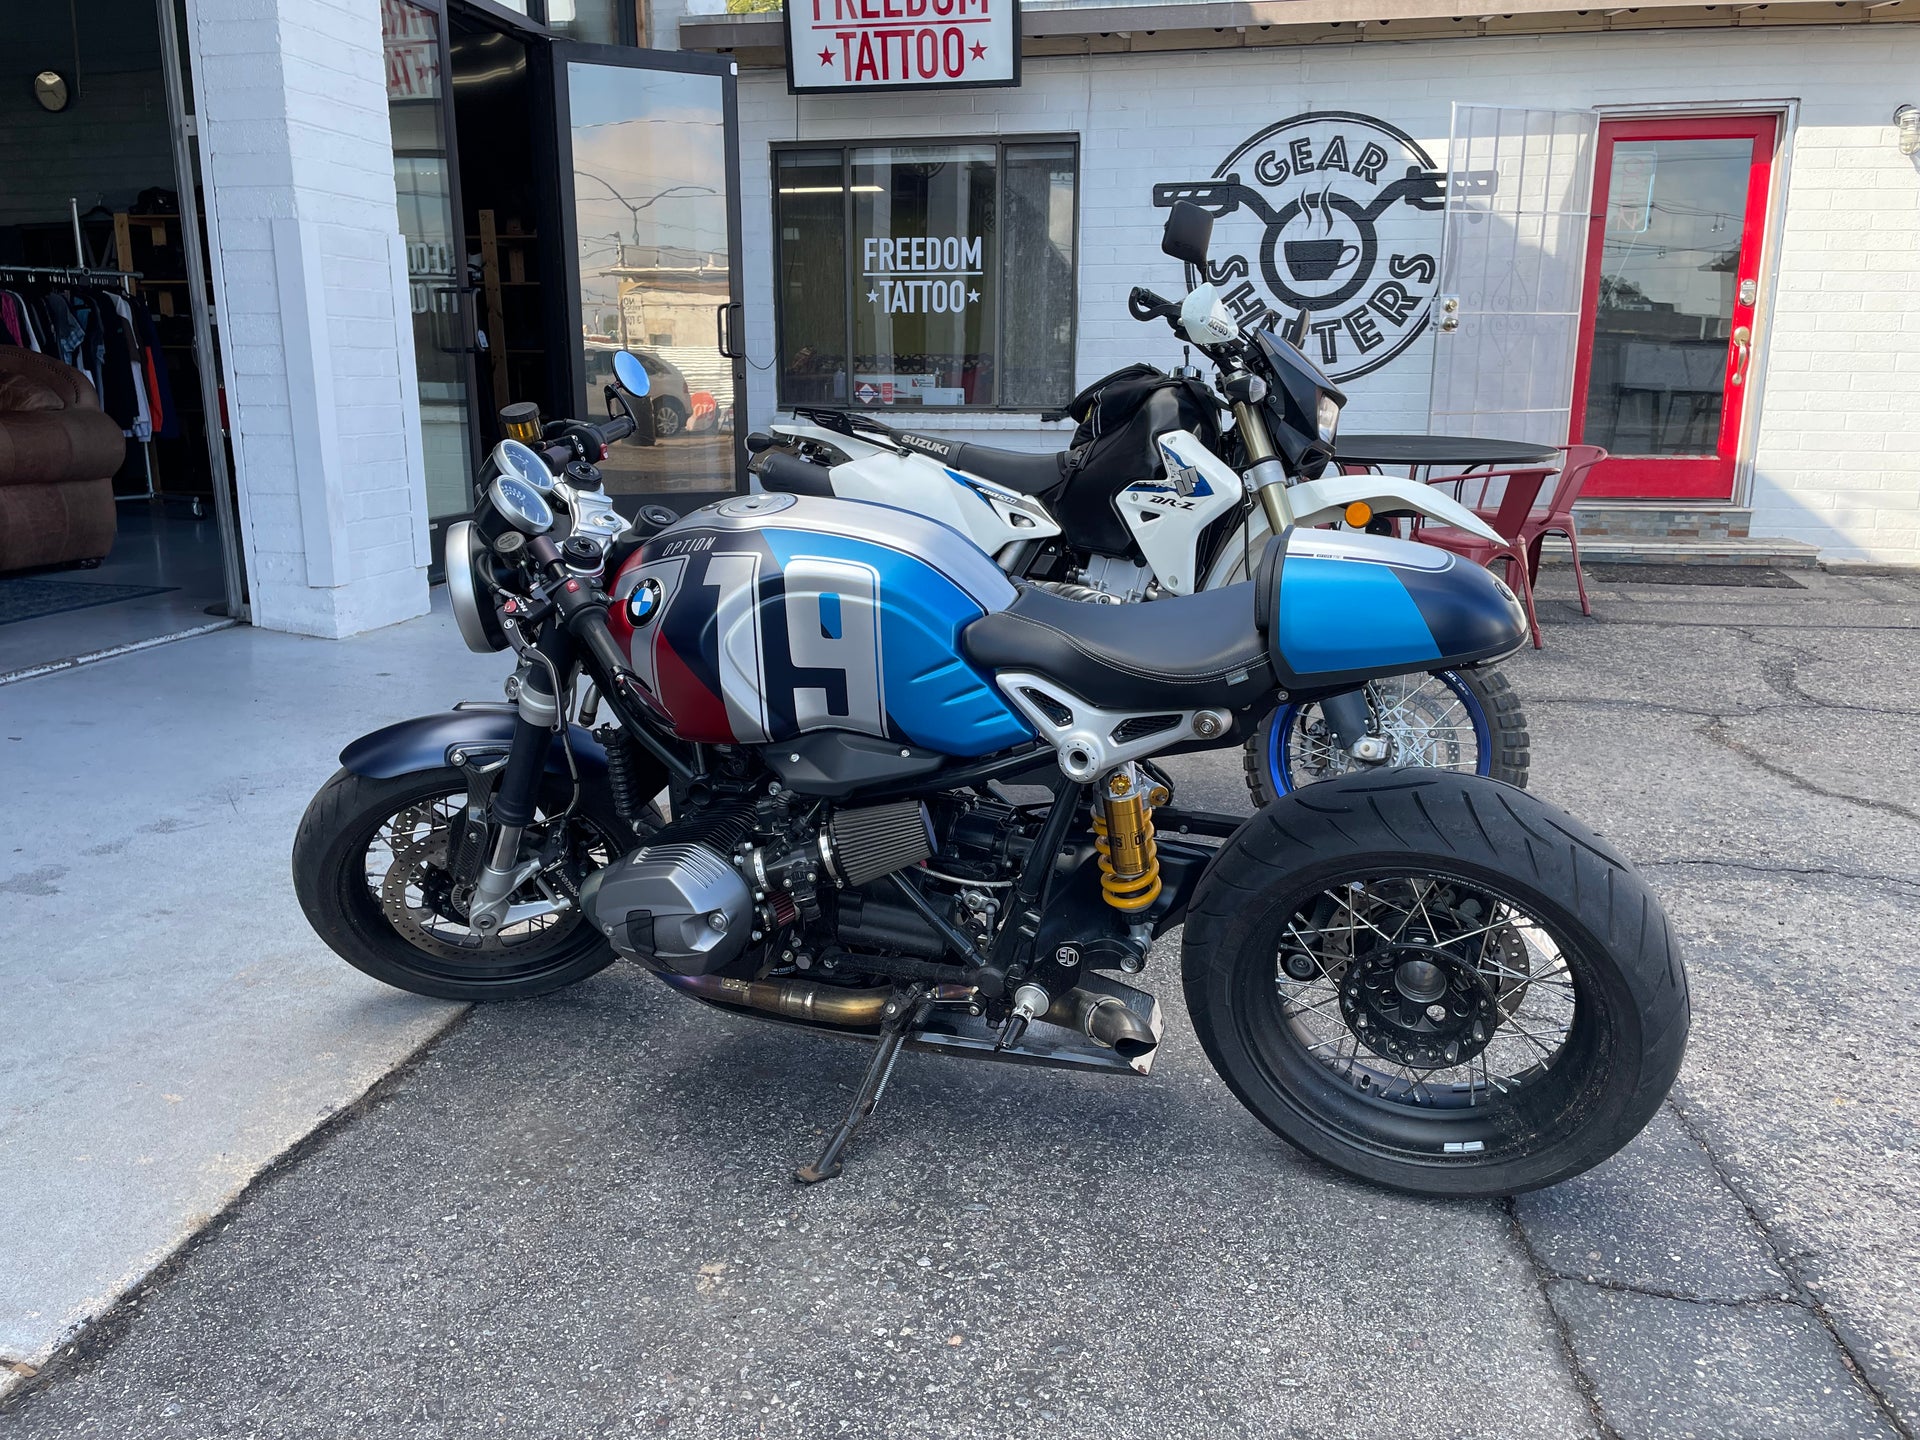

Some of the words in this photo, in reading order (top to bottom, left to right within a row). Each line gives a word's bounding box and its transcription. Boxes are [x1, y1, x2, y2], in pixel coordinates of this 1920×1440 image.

[835, 27, 965, 81] TATTOO
[1254, 135, 1389, 186] GEAR
[863, 236, 983, 271] FREEDOM
[879, 280, 966, 314] TATTOO
[901, 434, 950, 456] SUZUKI
[1149, 495, 1197, 511] DR-Z
[662, 536, 717, 557] OPTION
[555, 868, 580, 897] brembo
